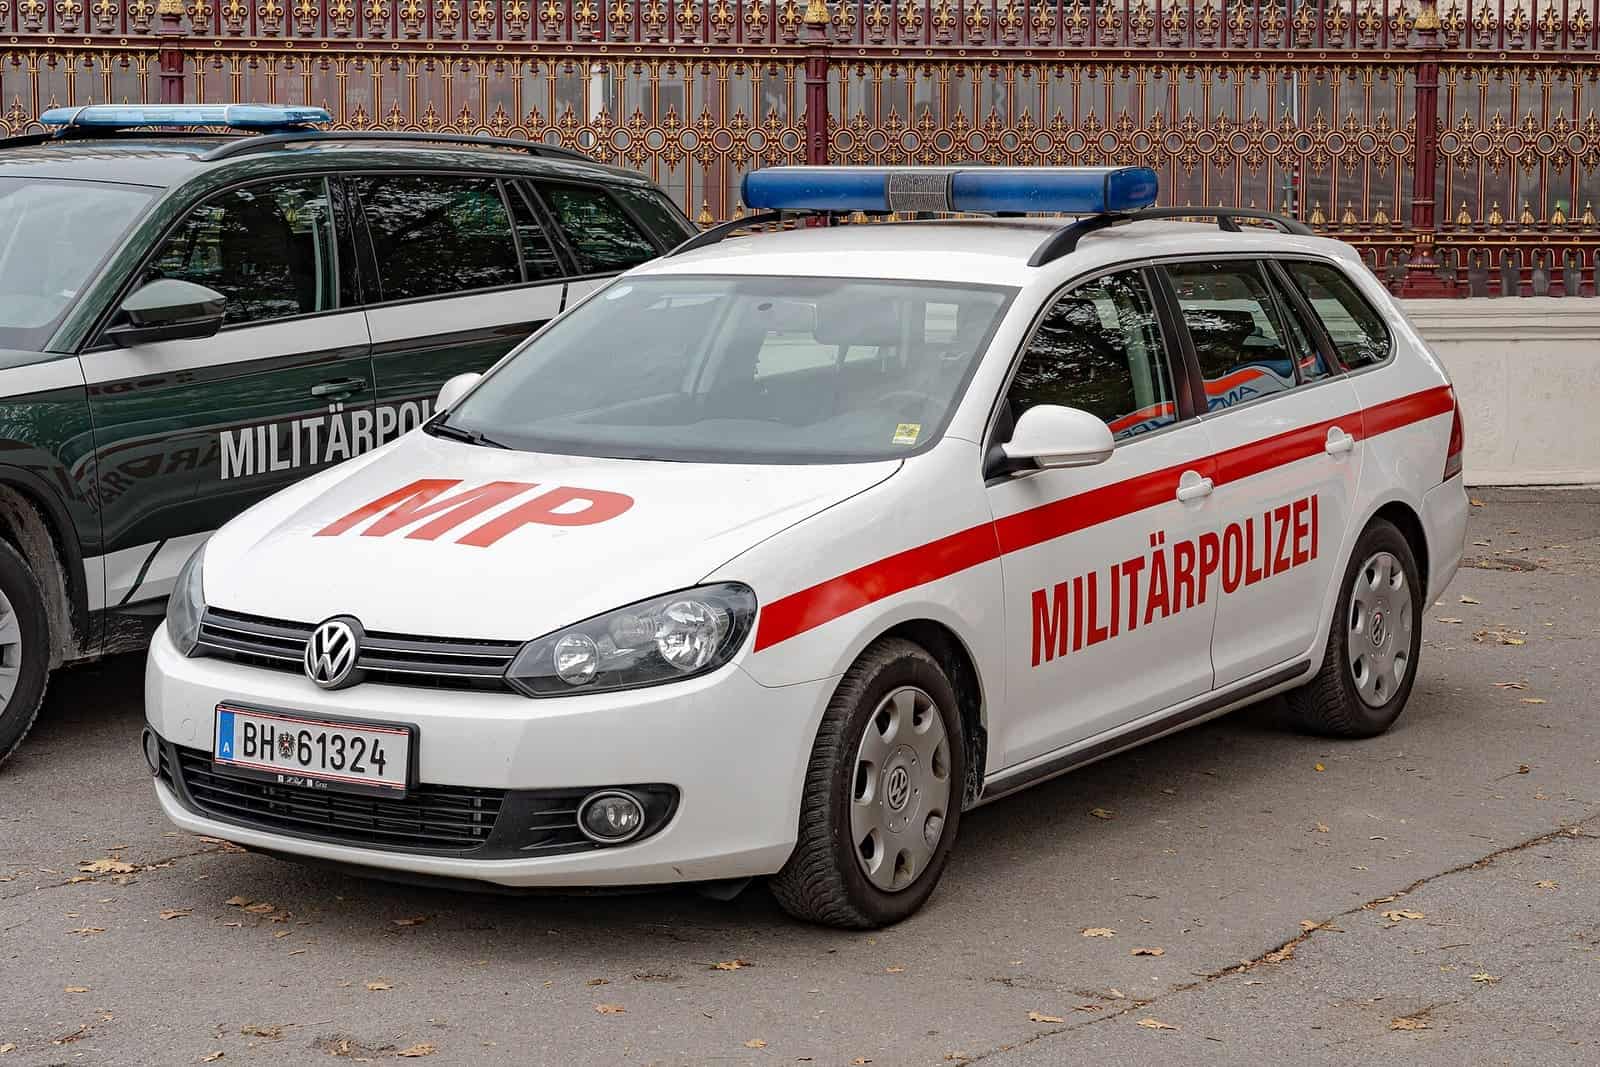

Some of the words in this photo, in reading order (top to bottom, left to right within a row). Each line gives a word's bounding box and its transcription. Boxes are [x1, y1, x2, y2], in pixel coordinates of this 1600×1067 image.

[312, 478, 634, 548] MP
[1031, 494, 1319, 667] MILITÄRPOLIZEI
[305, 621, 356, 686] VW
[222, 742, 231, 754] A
[243, 721, 275, 761] BH
[297, 730, 387, 776] 61324
